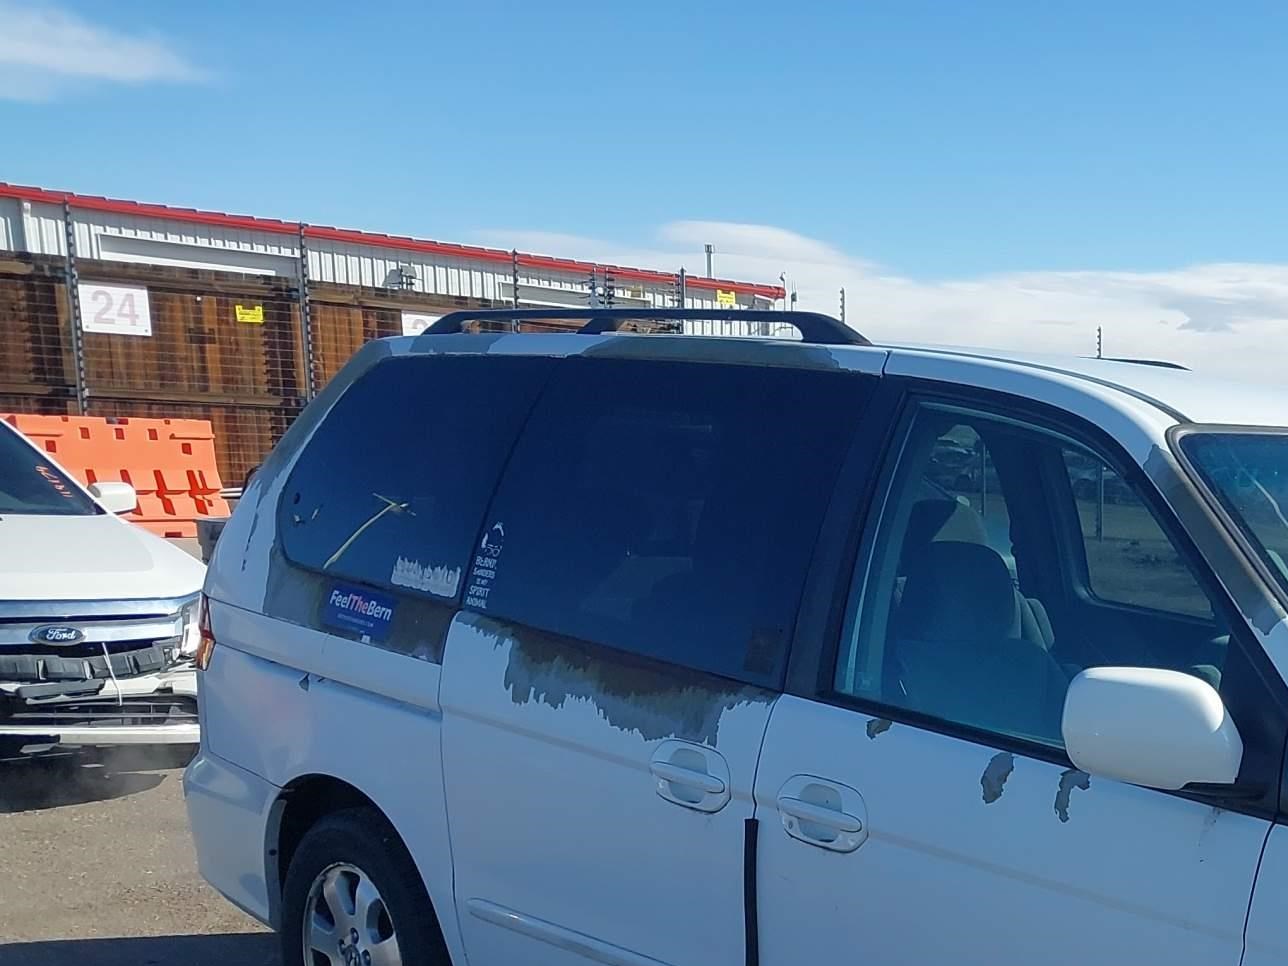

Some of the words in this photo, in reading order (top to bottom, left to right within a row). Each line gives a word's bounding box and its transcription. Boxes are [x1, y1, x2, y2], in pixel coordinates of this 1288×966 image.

[91, 289, 140, 326] 24
[329, 590, 392, 621] FeelTheBern
[46, 628, 76, 640] Ford
